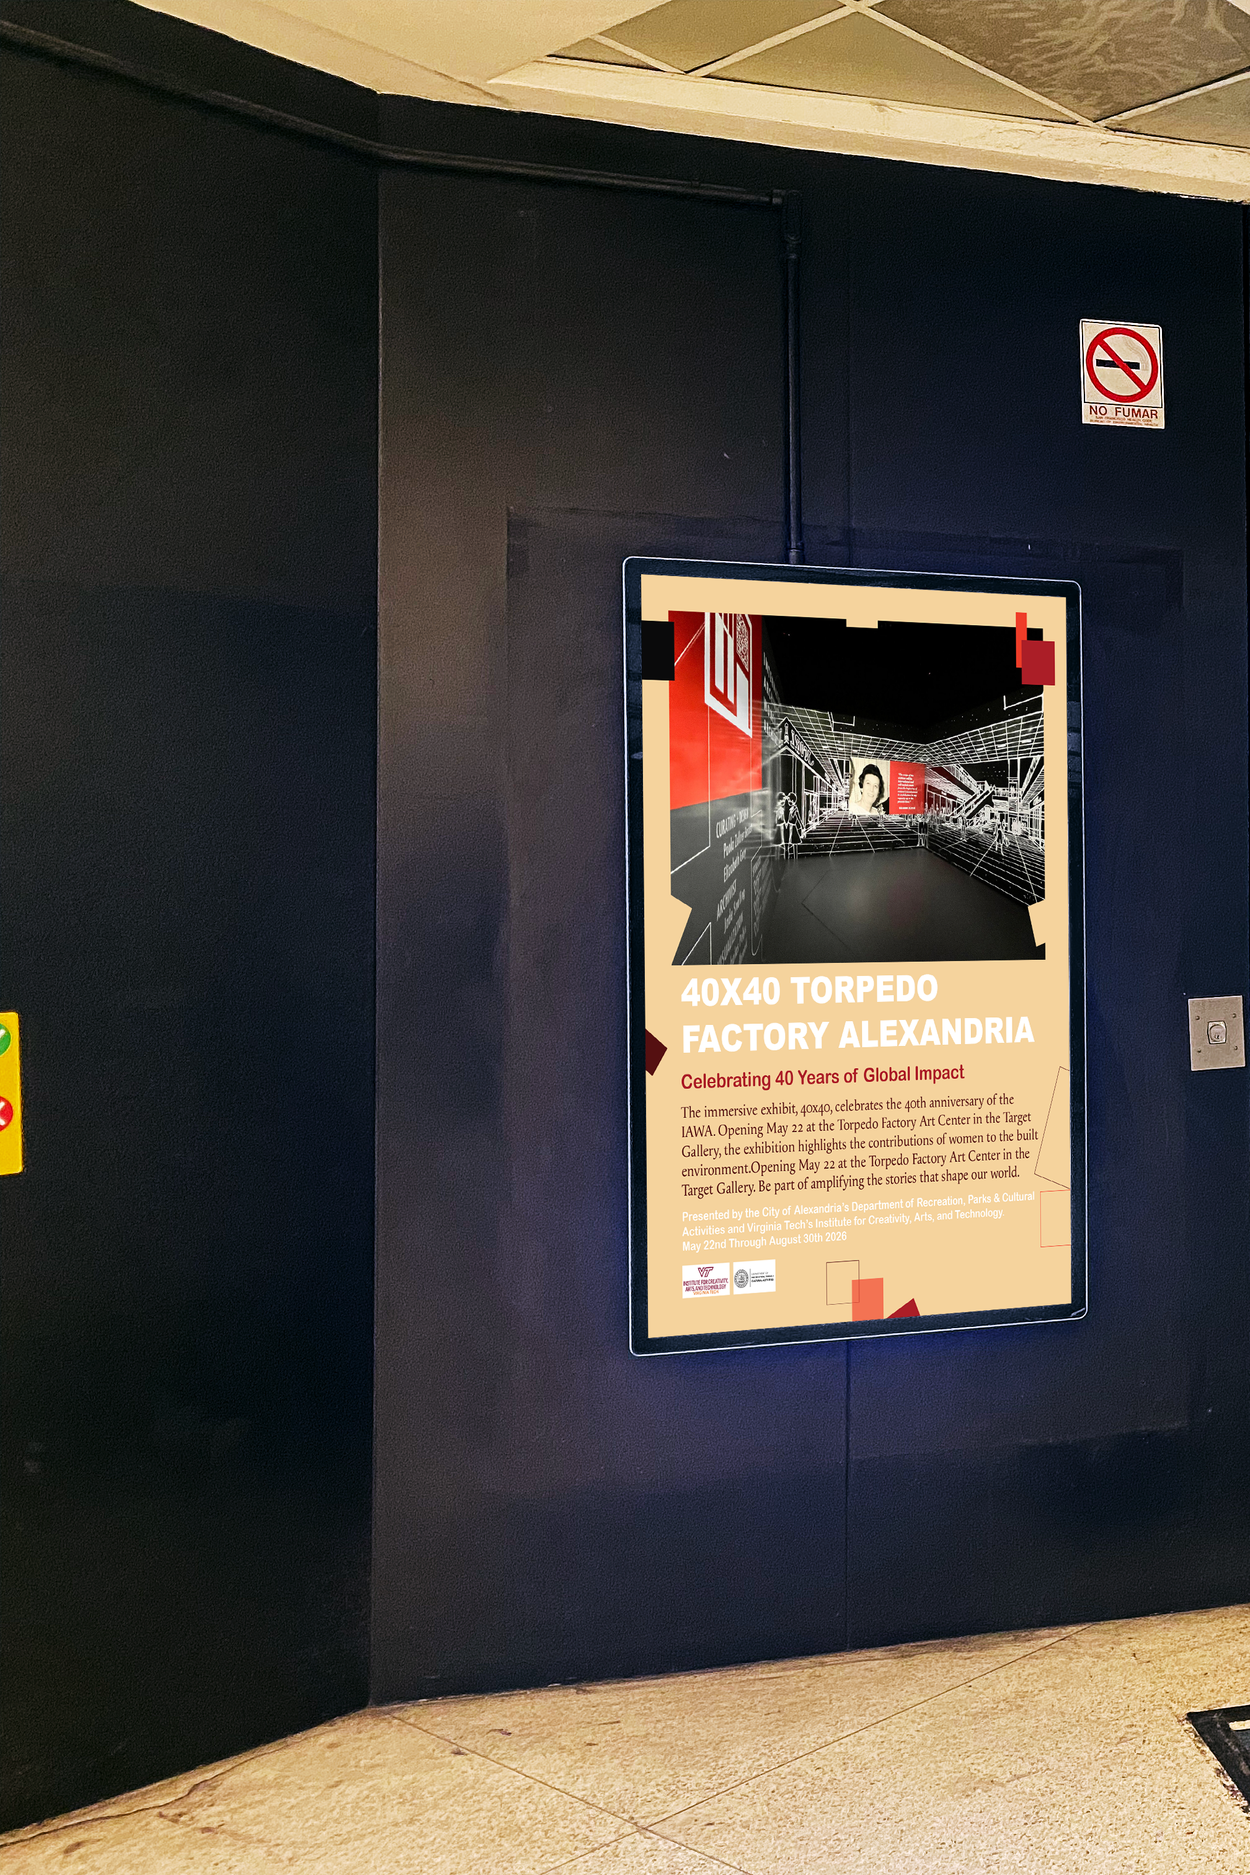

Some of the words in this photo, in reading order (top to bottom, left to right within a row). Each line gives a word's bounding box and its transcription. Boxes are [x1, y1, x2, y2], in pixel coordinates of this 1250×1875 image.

[1090, 405, 1107, 416] NO
[1115, 407, 1158, 419] FUMAR
[681, 977, 780, 1006] 40X40
[790, 974, 938, 1004] TORPEDO
[683, 1022, 829, 1053] FACTORY
[838, 1016, 1034, 1048] ALEXANDRIA
[682, 1072, 770, 1090] Celebrating
[775, 1070, 793, 1086] 40
[798, 1070, 839, 1084] Years
[844, 1068, 858, 1083] of
[864, 1066, 910, 1082] Global
[916, 1064, 965, 1084] Impact
[681, 1106, 700, 1118] The
[705, 1104, 757, 1117] immersive
[761, 1102, 798, 1116] exhibit,
[801, 1104, 832, 1117] 40x40,
[835, 1099, 883, 1112] celebrates
[886, 1098, 901, 1109] the
[905, 1096, 926, 1112] 40th
[930, 1096, 984, 1109] anniversary
[987, 1093, 997, 1105] of
[999, 1093, 1014, 1104] the
[682, 1125, 715, 1137] IAWA.
[718, 1123, 763, 1139] Opening
[767, 1122, 788, 1137] May
[792, 1124, 803, 1132] 22
[806, 1123, 815, 1132] at
[819, 1119, 834, 1131] the
[837, 1117, 878, 1133] Torpedo
[882, 1117, 916, 1130] Factory
[920, 1116, 935, 1126] Art
[938, 1115, 970, 1126] Center
[973, 1113, 982, 1124] in
[986, 1112, 1000, 1123] the
[1003, 1112, 1031, 1125] Target
[682, 1144, 721, 1160] Gallery,
[724, 1143, 740, 1155] the
[744, 1141, 794, 1154] exhibition
[799, 1138, 846, 1155] highlights
[850, 1137, 865, 1149] the
[869, 1134, 933, 1148] contributions
[937, 1132, 947, 1145] of
[949, 1135, 983, 1144] women
[987, 1134, 996, 1142] to
[1000, 1130, 1013, 1142] the
[1017, 1129, 1038, 1141] built
[799, 1159, 820, 1173] May
[824, 1161, 835, 1169] 22
[838, 1160, 847, 1168] at
[850, 1156, 866, 1168] the
[869, 1153, 909, 1169] Torpedo
[913, 1153, 946, 1166] Factory
[950, 1151, 965, 1162] Art
[968, 1150, 1000, 1161] Center
[1004, 1148, 1012, 1160] in
[1016, 1147, 1030, 1159] the
[682, 1184, 713, 1199] Target
[717, 1181, 755, 1196] Gallery.
[759, 1180, 771, 1192] Be
[774, 1181, 794, 1194] part
[798, 1177, 809, 1190] of
[811, 1175, 864, 1192] amplifying
[867, 1173, 882, 1186] the
[886, 1172, 916, 1184] stories
[920, 1170, 938, 1182] that
[942, 1169, 968, 1184] shape
[971, 1171, 987, 1180] our
[991, 1166, 1019, 1178] world.
[683, 1210, 729, 1221] Presented
[732, 1209, 743, 1220] by
[745, 1208, 759, 1218] the
[762, 1207, 780, 1218] City
[782, 1206, 791, 1215] of
[852, 1199, 903, 1212] Department
[906, 1198, 914, 1208] of
[917, 1196, 965, 1207] Recreation,
[968, 1194, 991, 1204] Parks
[994, 1193, 1000, 1202] &
[1002, 1191, 1034, 1202] Cultural
[682, 1226, 725, 1236] Activities
[728, 1224, 744, 1234] and
[747, 1222, 781, 1234] Virginia
[816, 1217, 851, 1228] Institute
[854, 1216, 866, 1225] for
[868, 1214, 912, 1224] Creativity,
[914, 1212, 934, 1222] Arts,
[937, 1210, 952, 1220] and
[683, 1242, 701, 1253] May
[704, 1239, 726, 1250] 22nd
[729, 1237, 766, 1248] Through
[769, 1234, 801, 1247] August
[804, 1233, 822, 1243] 30th
[826, 1231, 846, 1242] 2026
